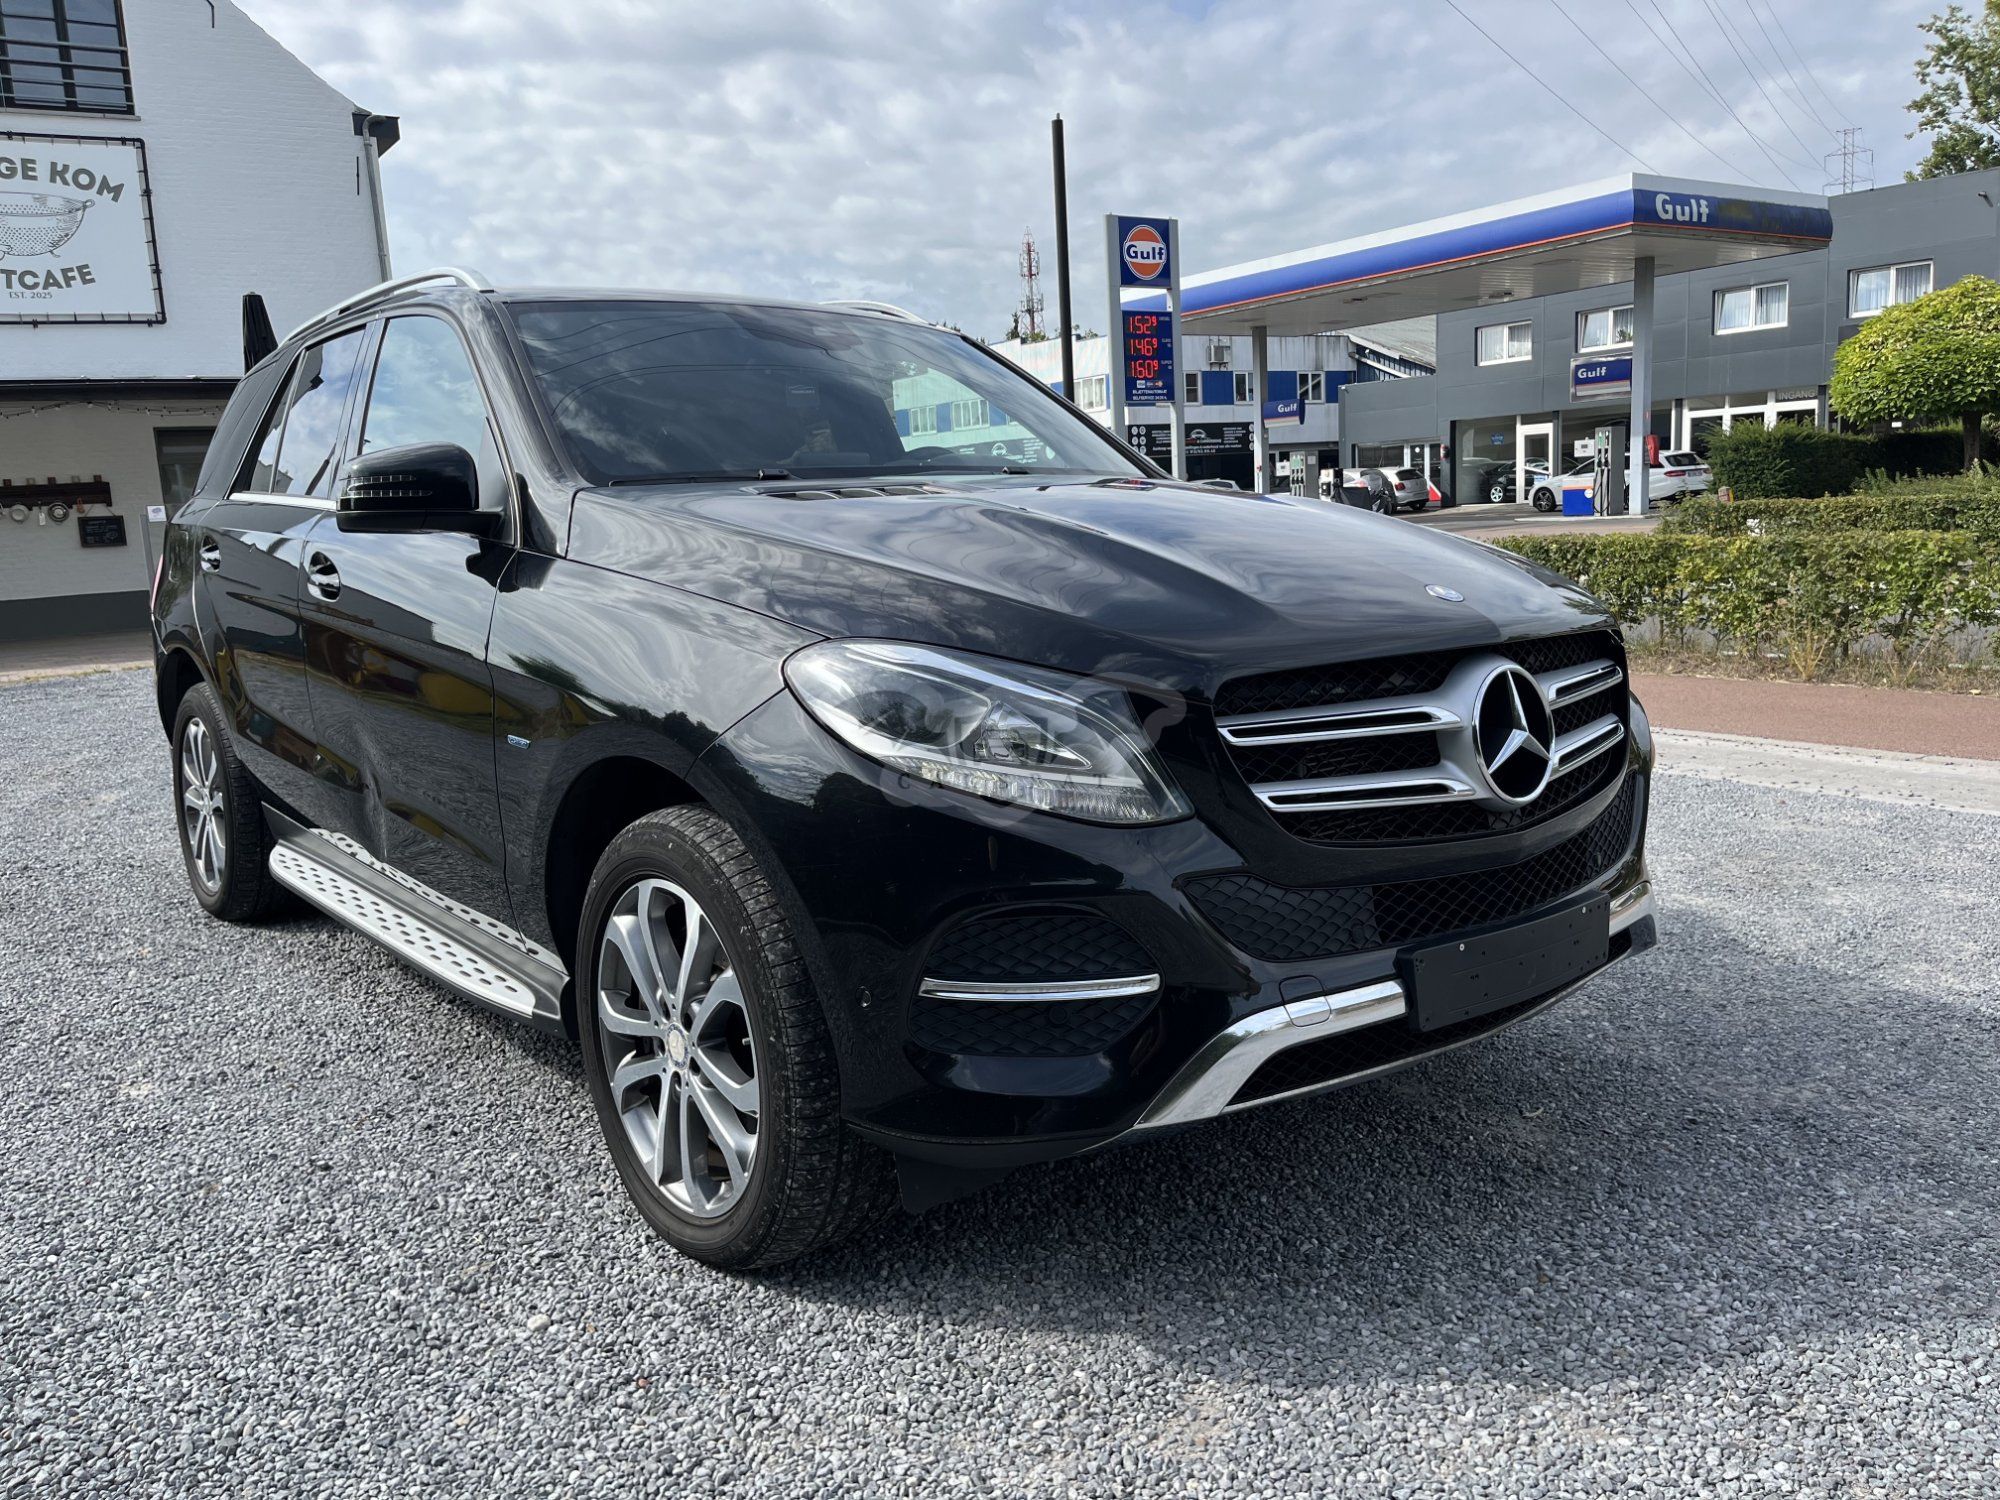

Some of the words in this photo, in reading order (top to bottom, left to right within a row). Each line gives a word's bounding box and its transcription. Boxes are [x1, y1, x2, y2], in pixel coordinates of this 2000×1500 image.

[49, 161, 125, 203] KOM
[1655, 192, 1710, 223] Gulf
[1125, 243, 1166, 261] Gulf
[0, 264, 96, 291] TCAFE
[9, 291, 27, 299] EST.
[30, 291, 53, 299] 2025
[1577, 366, 1607, 379] Gulf
[1778, 389, 1816, 401] INGANG
[1277, 403, 1298, 413] Gulf
